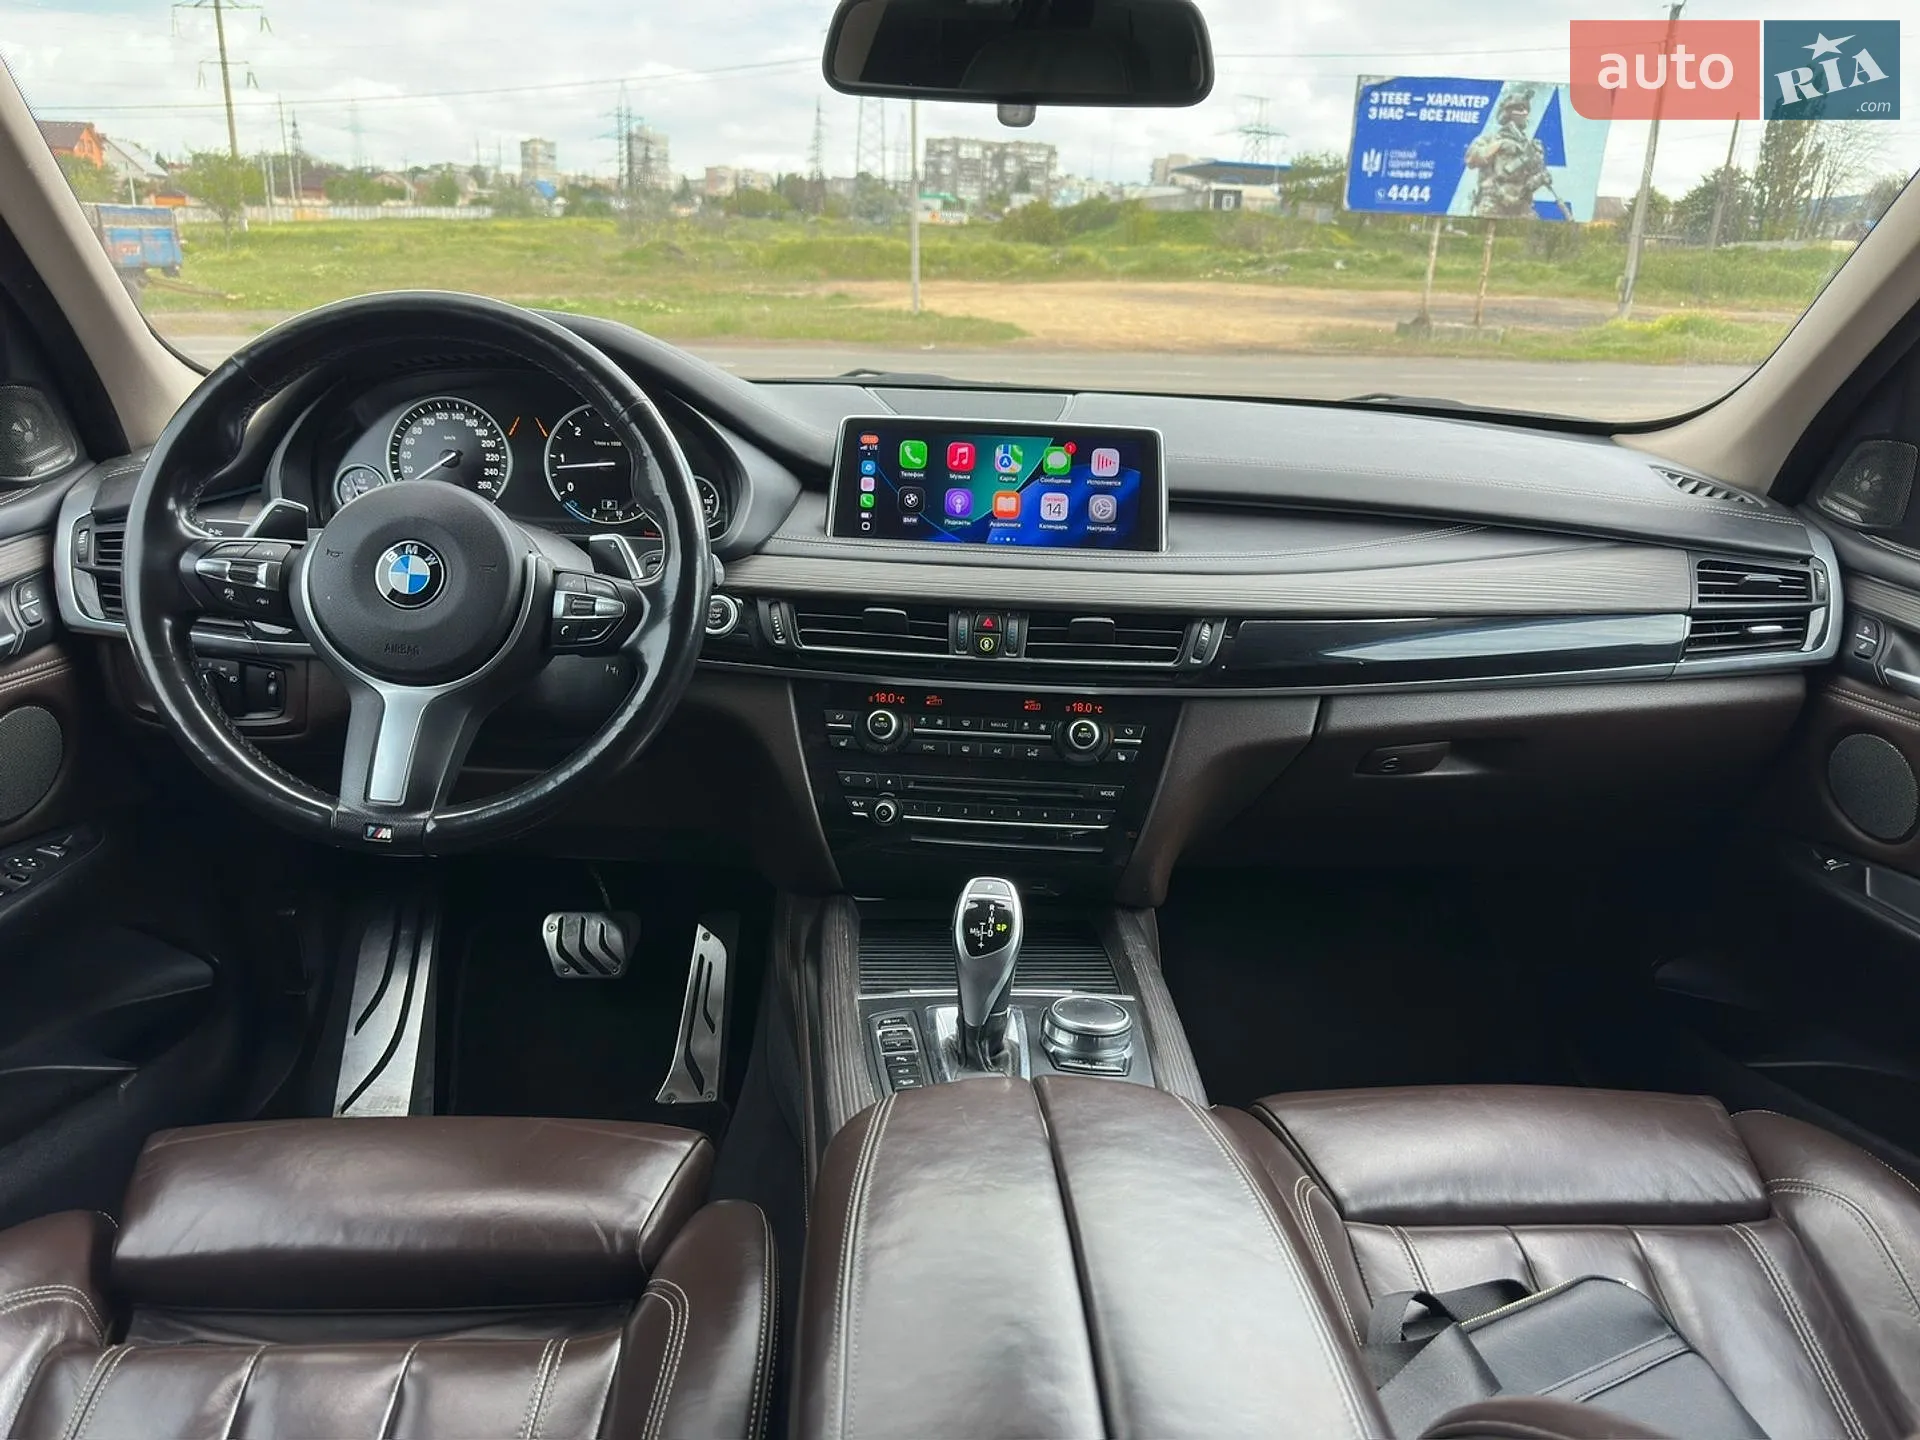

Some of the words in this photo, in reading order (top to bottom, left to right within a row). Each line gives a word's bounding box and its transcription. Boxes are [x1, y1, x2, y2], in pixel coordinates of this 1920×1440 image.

[1381, 92, 1412, 105] ТЕБЕ
[1426, 93, 1489, 108] ХАРАКТЕР
[1379, 107, 1404, 120] НАС
[1419, 109, 1443, 122] ВСЕ
[1388, 184, 1431, 202] 4444
[422, 418, 435, 426] 100
[412, 427, 422, 435] 80
[574, 427, 581, 436] 2
[560, 454, 565, 462] 1
[484, 468, 498, 476] 240
[567, 482, 574, 491] 0
[1047, 503, 1062, 516] 14
[386, 544, 438, 566] BMW
[875, 693, 895, 703] 18.0
[1072, 702, 1092, 713] 18.0
